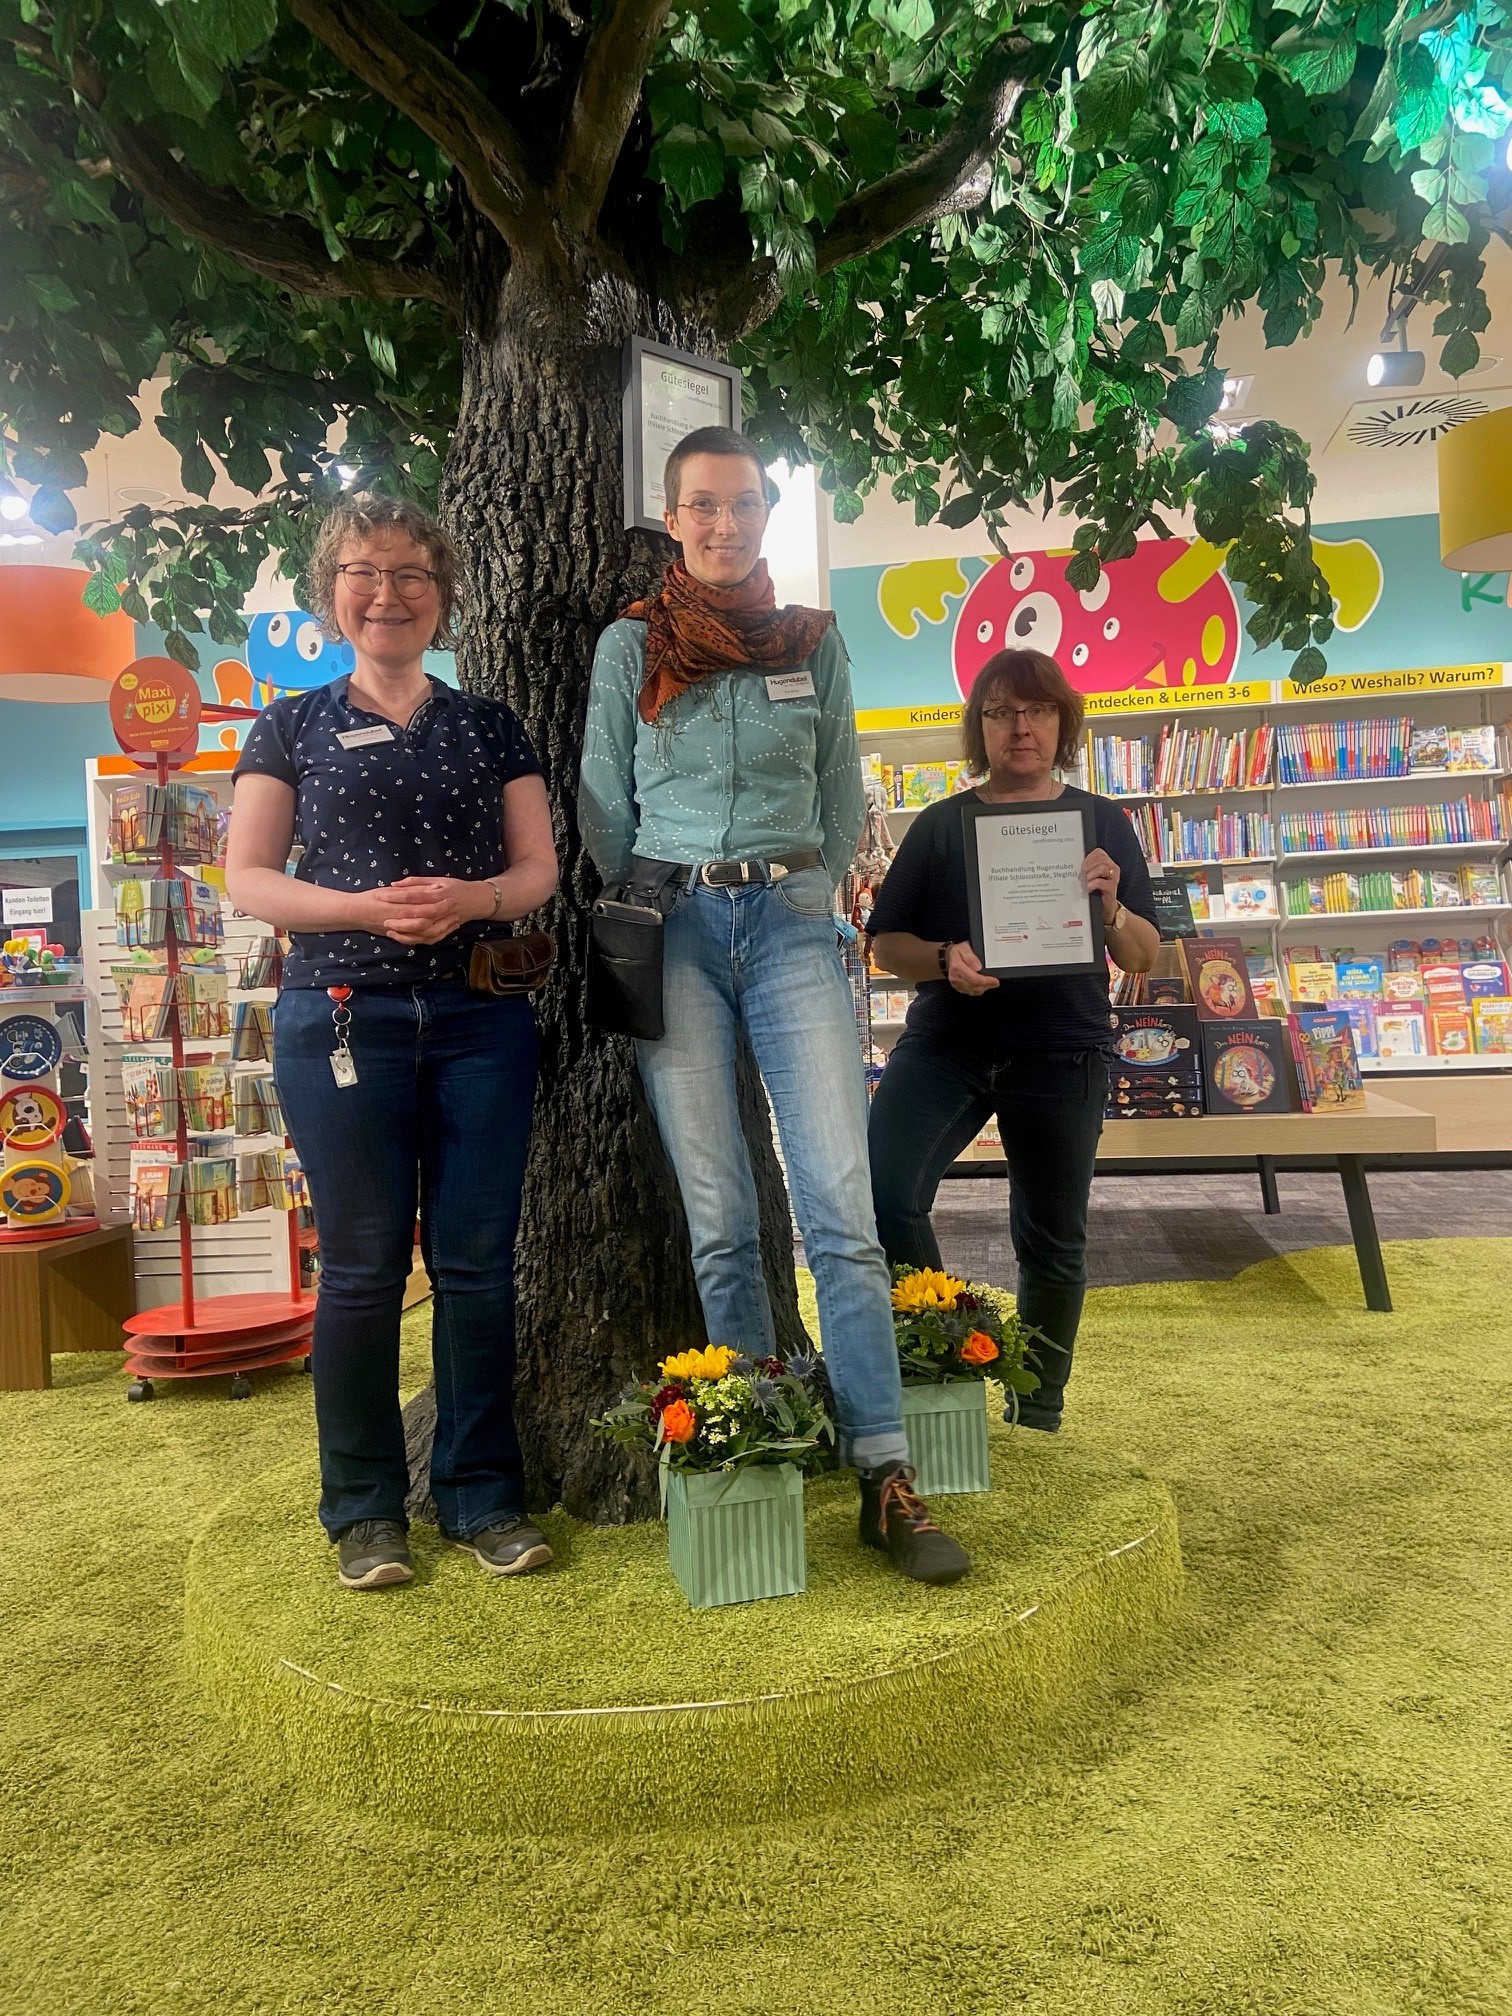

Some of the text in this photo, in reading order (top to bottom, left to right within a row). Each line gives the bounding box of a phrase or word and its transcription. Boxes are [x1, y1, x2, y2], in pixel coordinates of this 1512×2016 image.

[661, 371, 709, 395] Gütesiegel
[650, 412, 688, 430] Buchhandlung
[770, 675, 808, 686] Hugendubel
[1292, 667, 1494, 695] Wieso? Weshalb? Warum?
[137, 684, 171, 701] Maxi
[1083, 686, 1250, 710] Entdecken & Lernen 3-6
[142, 701, 170, 720] pixi
[1001, 823, 1058, 836] Gütesiegel
[988, 870, 1078, 882] (Filiale Schlossstraße, Steglitz)
[991, 863, 1074, 874] Buchhandlung Hugendubel
[1311, 1024, 1336, 1041] Pippi
[1213, 1041, 1228, 1050] Das
